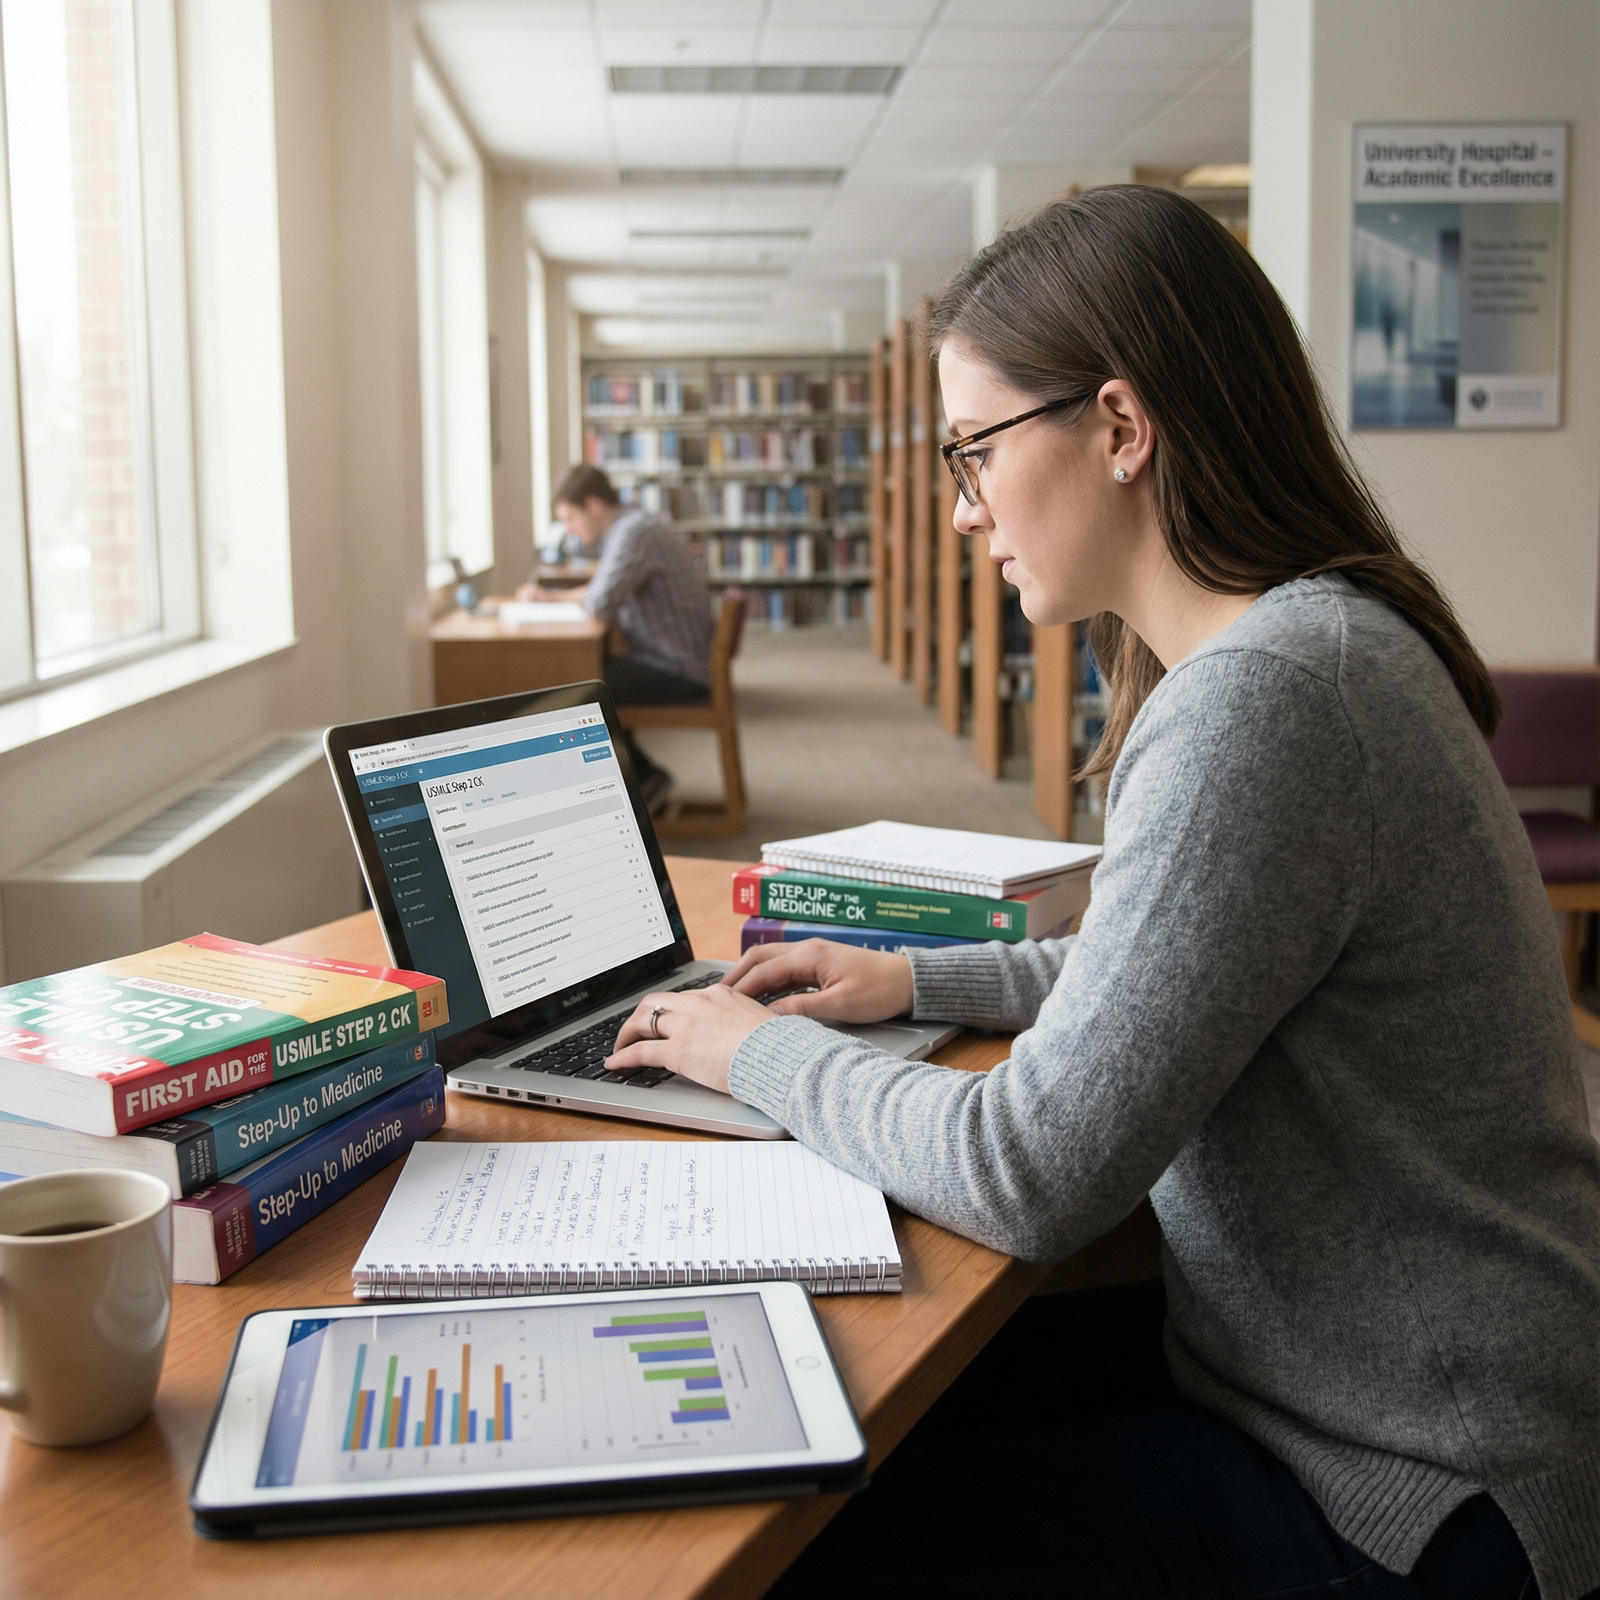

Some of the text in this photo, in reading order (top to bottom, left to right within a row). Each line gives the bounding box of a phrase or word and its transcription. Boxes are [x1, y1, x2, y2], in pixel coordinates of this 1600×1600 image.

[1364, 140, 1456, 166] University
[1461, 140, 1536, 165] Hospital
[1363, 166, 1556, 188] Academic Excellence
[473, 776, 485, 788] CK
[768, 882, 828, 902] STEP-UP
[768, 897, 836, 918] MEDICINE
[845, 905, 867, 921] CK
[109, 997, 243, 1030] STEP
[275, 1028, 333, 1067] USMLE
[336, 1015, 375, 1047] STEP
[377, 1011, 388, 1035] 2
[390, 1003, 412, 1029] CK
[247, 1051, 266, 1066] FOR
[248, 1062, 267, 1076] THE
[125, 1072, 198, 1118] FIRST
[204, 1058, 244, 1092] AID
[237, 1103, 301, 1149] Step-Up
[303, 1096, 318, 1117] to
[321, 1064, 384, 1109] Medicine
[258, 1118, 403, 1226] Step-Up to Medicine
